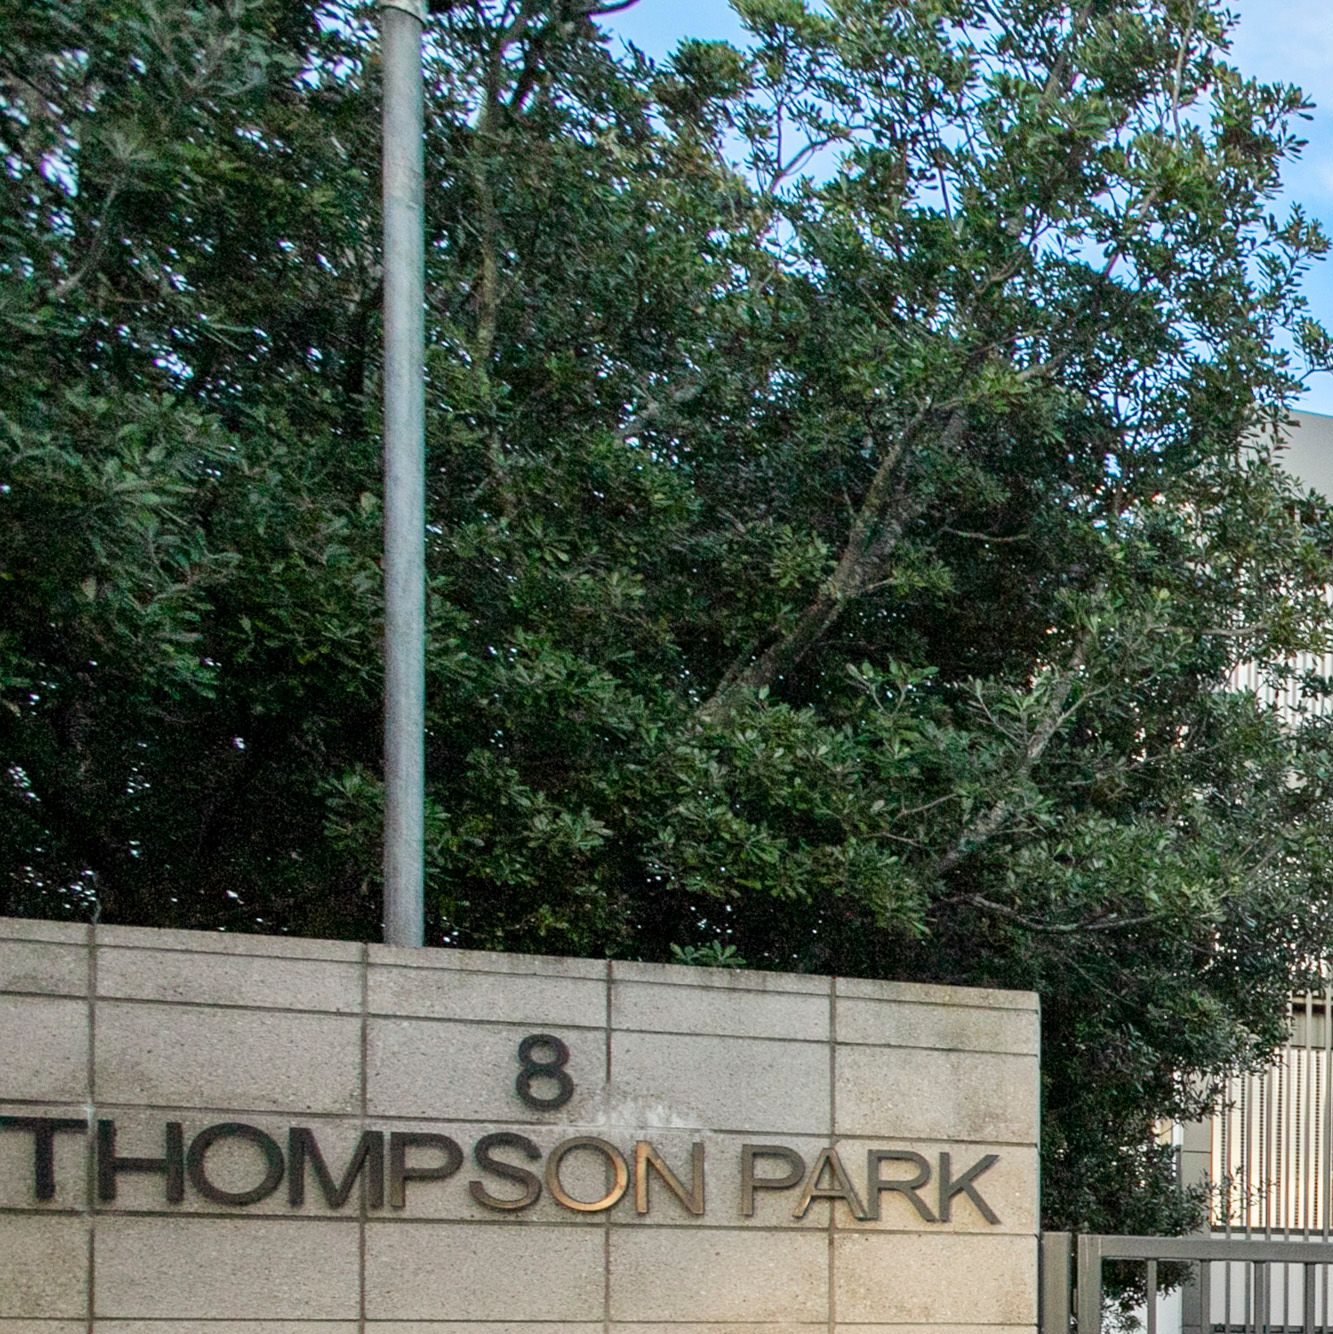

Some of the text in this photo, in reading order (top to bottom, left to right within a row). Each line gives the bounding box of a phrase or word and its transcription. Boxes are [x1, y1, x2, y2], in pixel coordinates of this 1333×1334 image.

[514, 1033, 575, 1112] 8
[0, 1115, 1002, 1226] THOMPSON PARK
